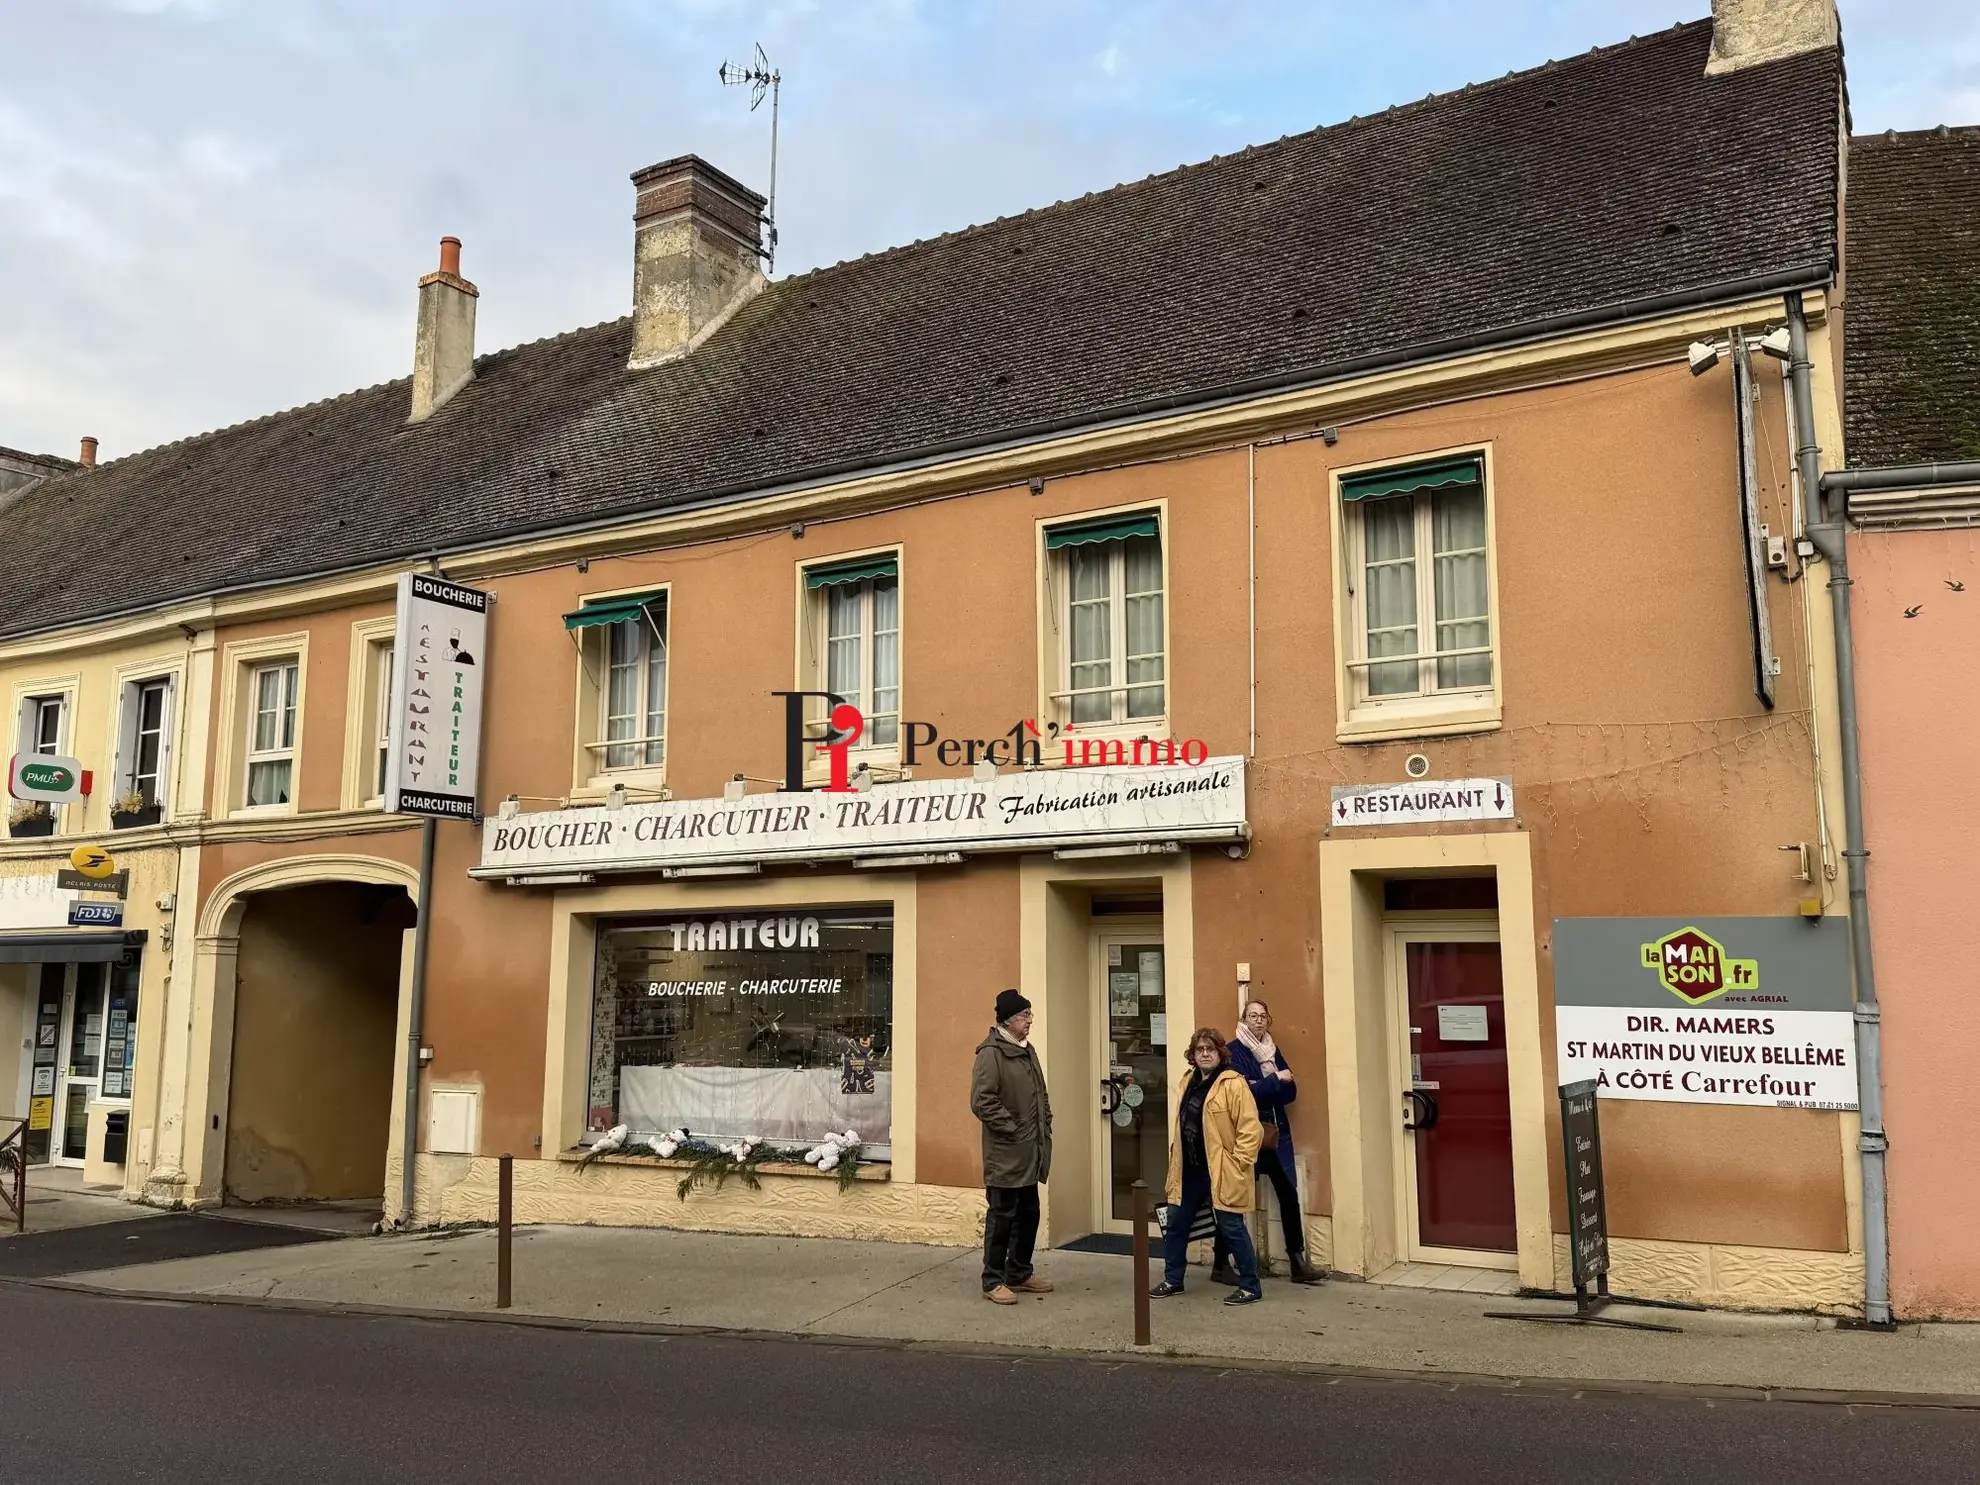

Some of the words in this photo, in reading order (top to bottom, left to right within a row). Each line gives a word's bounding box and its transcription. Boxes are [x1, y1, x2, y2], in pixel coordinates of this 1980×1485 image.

[415, 580, 484, 607] BOUCHERIE
[448, 671, 463, 786] TRAITEUR
[26, 771, 52, 783] PMU
[401, 795, 473, 814] CHARCUTERIE
[492, 818, 613, 852] BOUCHER
[634, 804, 811, 842] CHARCUTIER
[836, 792, 987, 828] TRAITEUR
[998, 787, 1119, 824] Fabrication
[1126, 771, 1231, 801] artisanale
[1353, 789, 1484, 814] RESTAURANT
[78, 907, 101, 919] FDJ
[670, 917, 820, 952] TRAITEUR
[1645, 948, 1660, 963] la
[648, 980, 727, 997] BOUCHERIE
[739, 978, 842, 995] CHARCUTERIE
[1750, 995, 1789, 1003] AGRIAL
[1627, 1016, 1669, 1033] DIR.
[1676, 1017, 1775, 1035] MAMERS
[1566, 1041, 1588, 1058] ST
[1592, 1042, 1663, 1060] MARTIN
[1669, 1044, 1696, 1062] DU
[1700, 1045, 1756, 1064] VIEUX
[1762, 1042, 1846, 1066] BELLÊME
[1596, 1068, 1610, 1088] À
[1616, 1069, 1674, 1090] CÔTÉ
[1681, 1070, 1816, 1097] Carrefour
